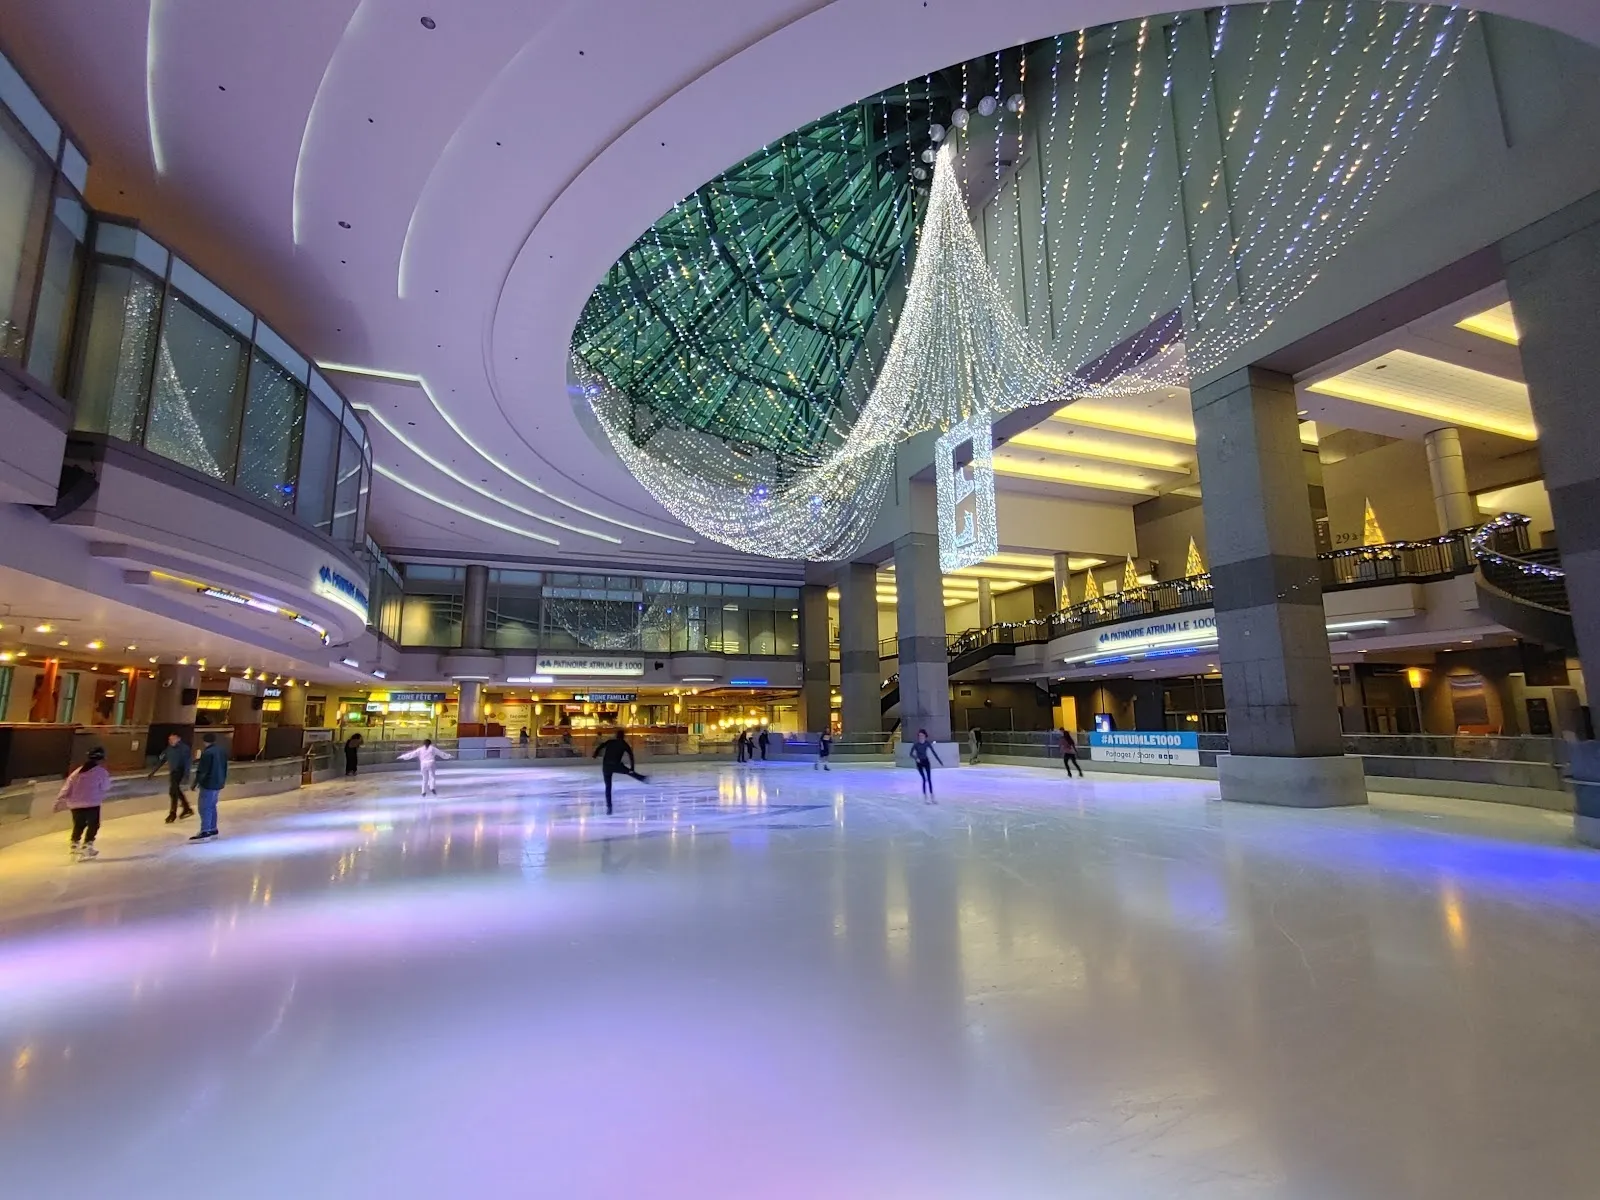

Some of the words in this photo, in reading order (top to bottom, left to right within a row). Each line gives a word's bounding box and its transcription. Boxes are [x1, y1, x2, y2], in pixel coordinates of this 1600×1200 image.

[1110, 627, 1144, 641] PATINOIRE
[1146, 622, 1176, 635] ATRIUM
[1178, 620, 1190, 631] LE
[553, 660, 587, 669] PATINOIRE
[589, 660, 613, 669] ATRIUM
[614, 661, 623, 669] LE
[625, 662, 642, 670] 1000
[1101, 734, 1182, 746] #ATRIUMLE1000
[1136, 751, 1155, 760] Share
